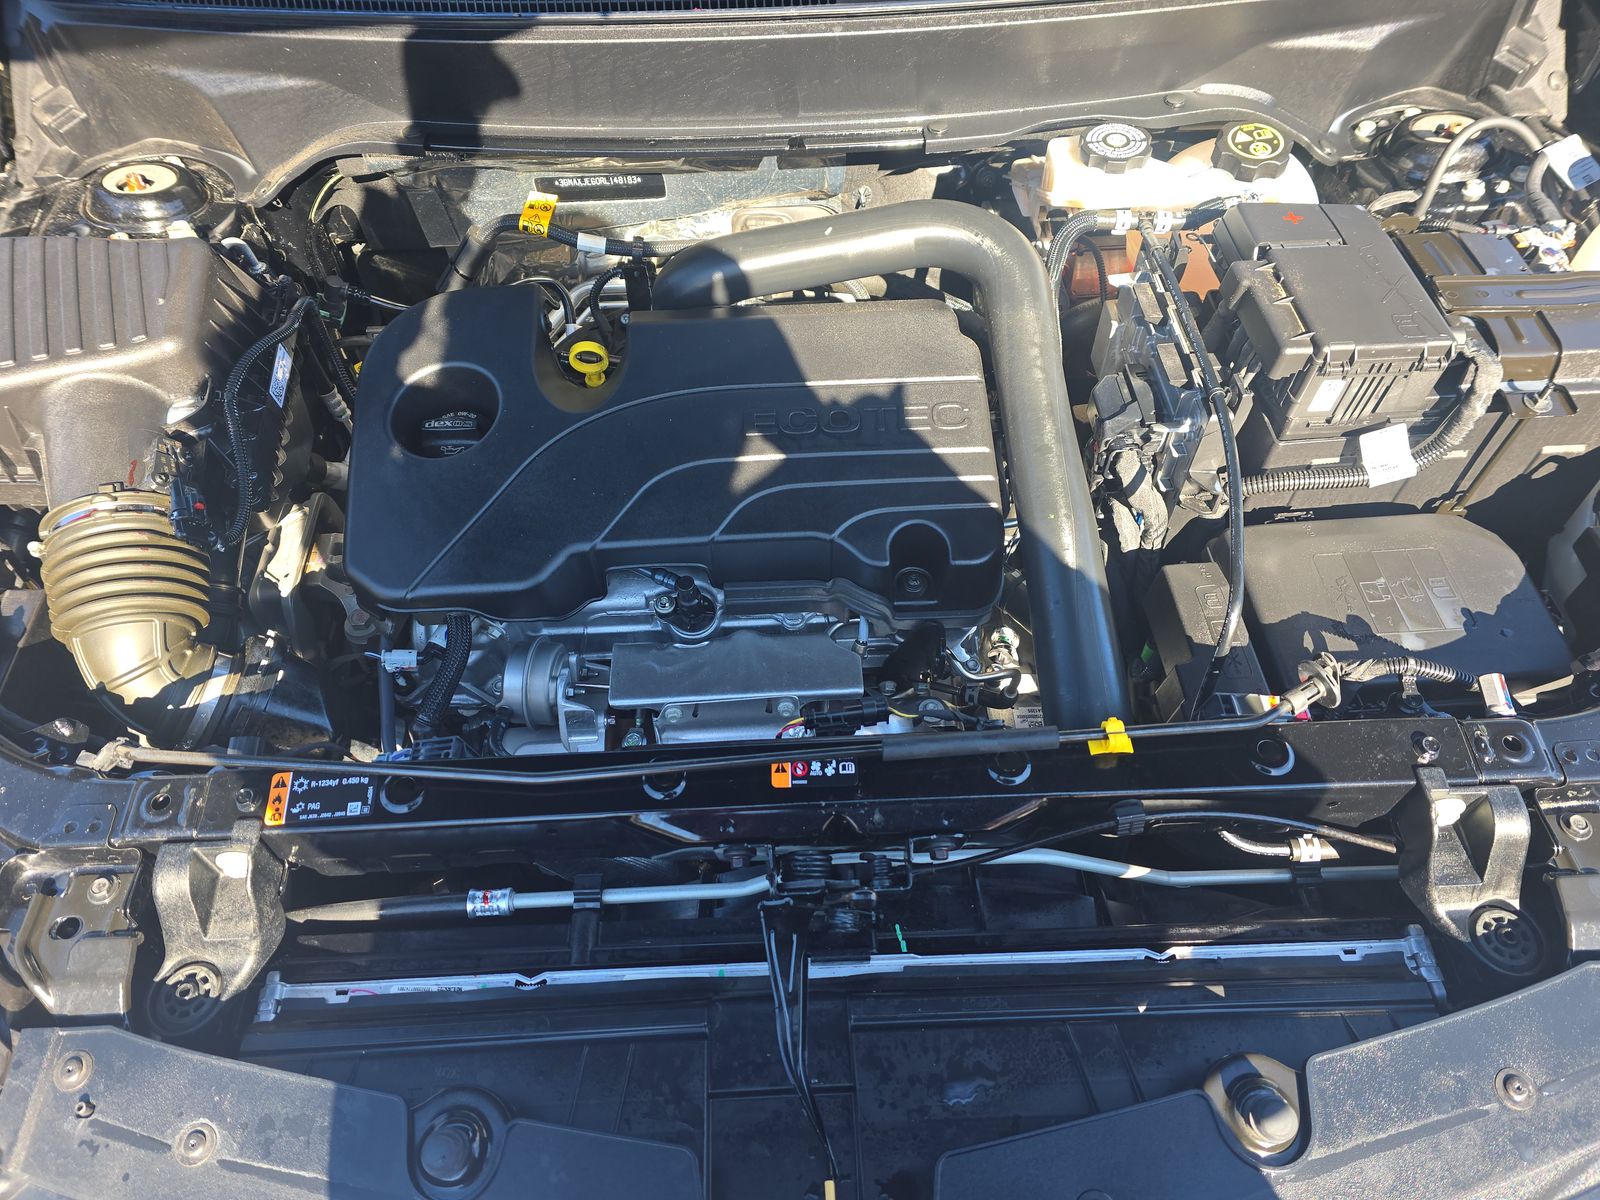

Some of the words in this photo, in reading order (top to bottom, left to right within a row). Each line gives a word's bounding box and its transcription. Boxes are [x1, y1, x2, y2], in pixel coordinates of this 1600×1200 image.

[745, 402, 970, 436] ECOTEC
[424, 420, 473, 428] dexos
[360, 776, 369, 785] kg
[307, 802, 321, 811] PAG
